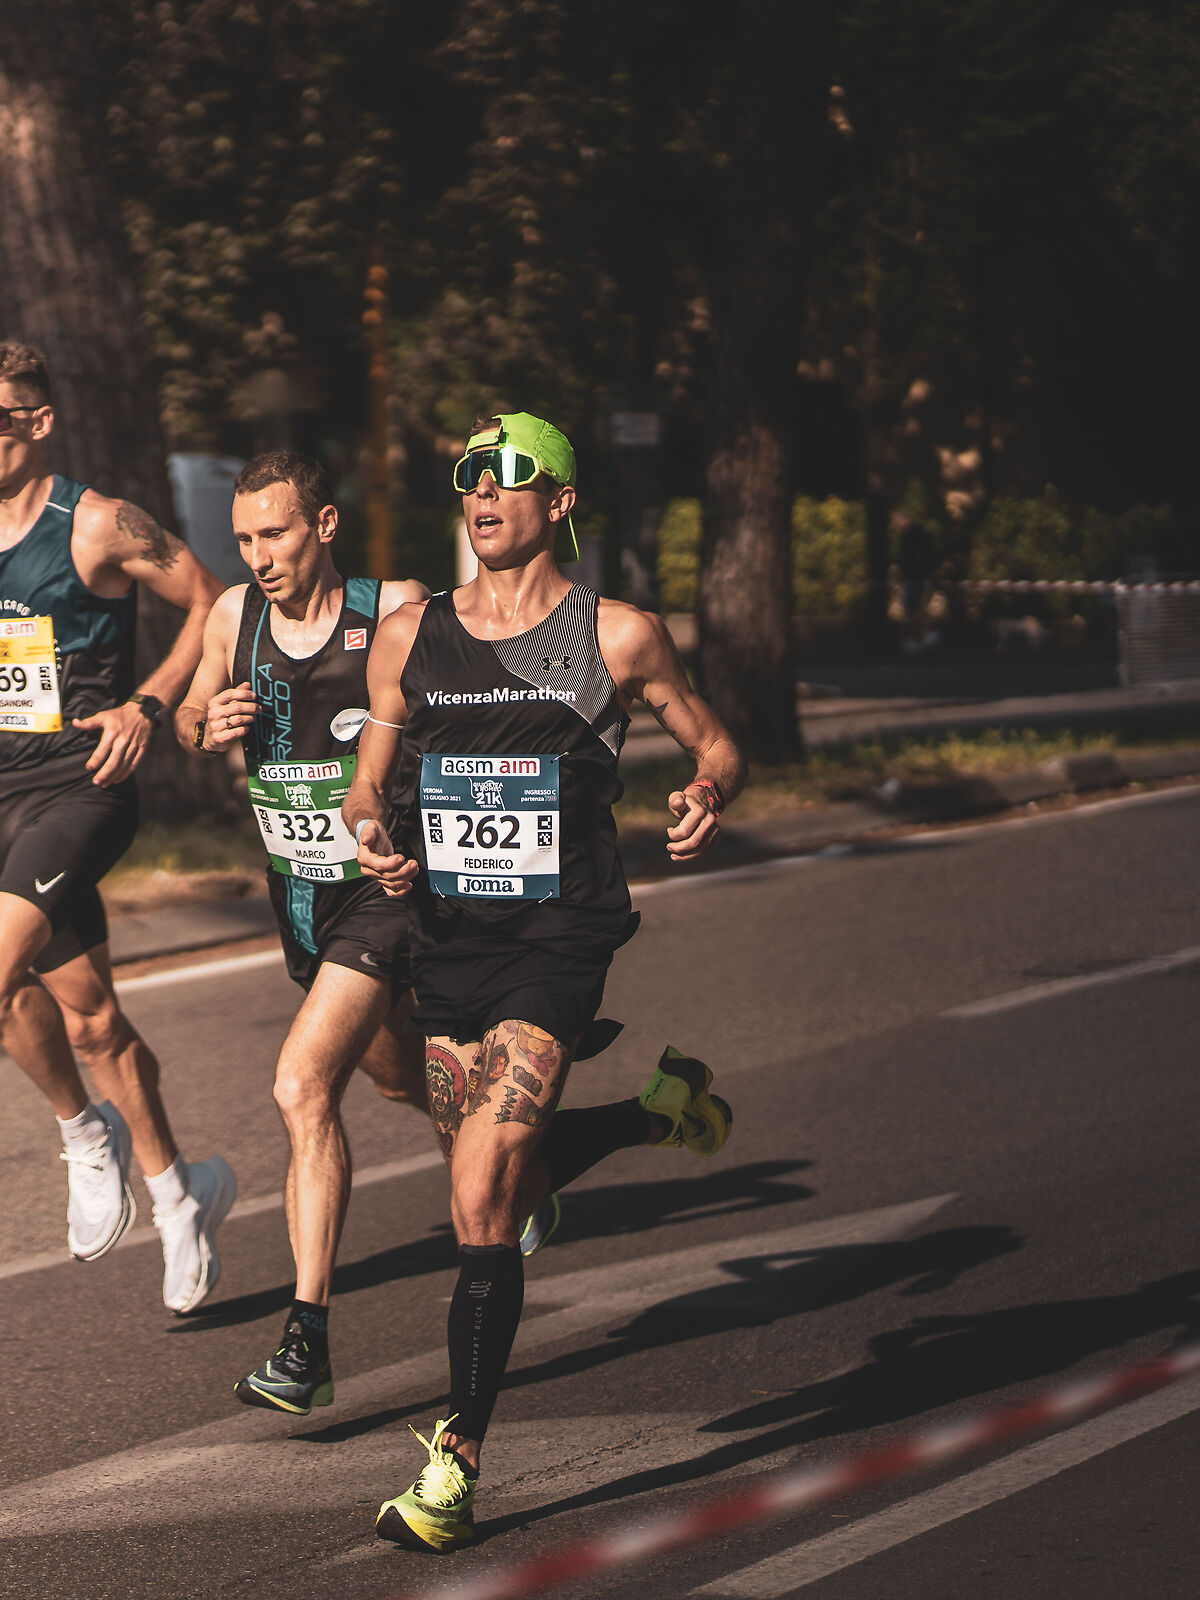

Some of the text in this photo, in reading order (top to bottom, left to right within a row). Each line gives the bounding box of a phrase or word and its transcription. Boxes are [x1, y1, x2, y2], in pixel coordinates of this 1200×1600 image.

[426, 685, 576, 706] VicenzaMarathon
[274, 681, 293, 763] RNICO
[278, 813, 335, 843] 332
[455, 814, 521, 849] 262
[295, 849, 326, 859] MARCO
[464, 857, 514, 870] FEDERICO
